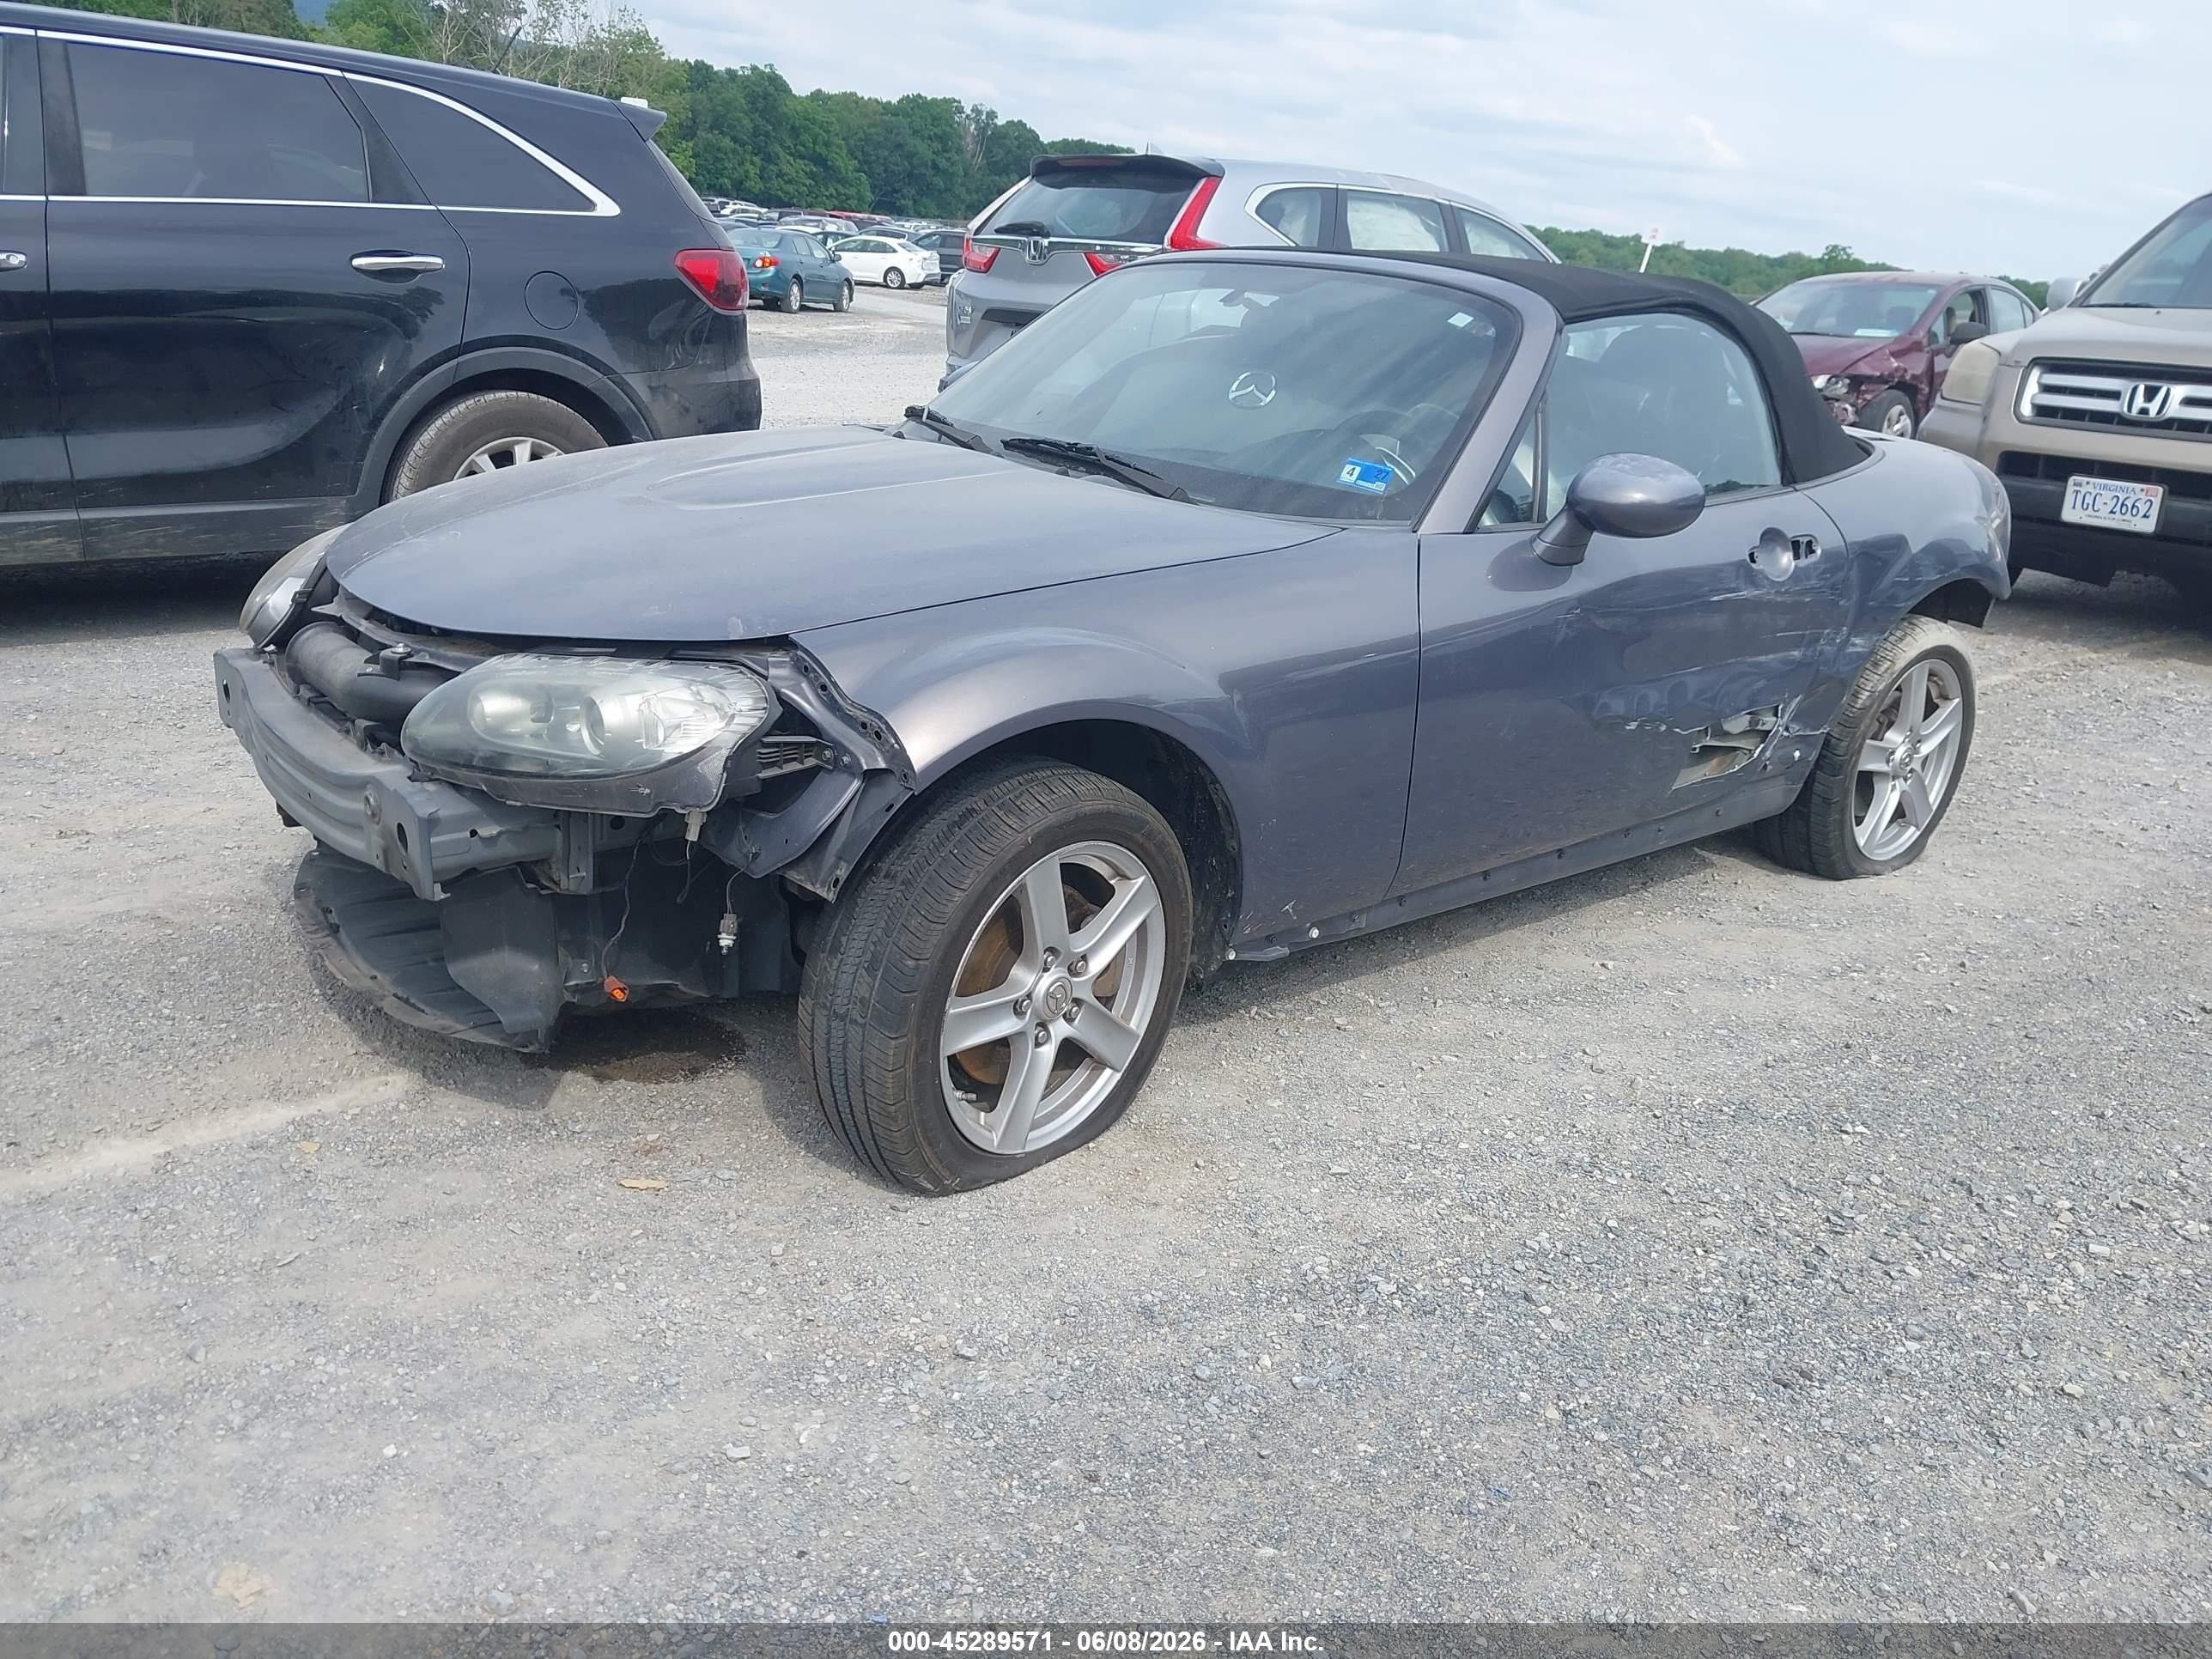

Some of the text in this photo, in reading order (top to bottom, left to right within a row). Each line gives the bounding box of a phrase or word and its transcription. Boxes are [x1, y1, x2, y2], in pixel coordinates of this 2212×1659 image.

[1346, 466, 1357, 477] 4
[1374, 470, 1389, 480] 27
[2093, 483, 2136, 495] VIRGINIA
[2071, 489, 2154, 519] TGC-2662
